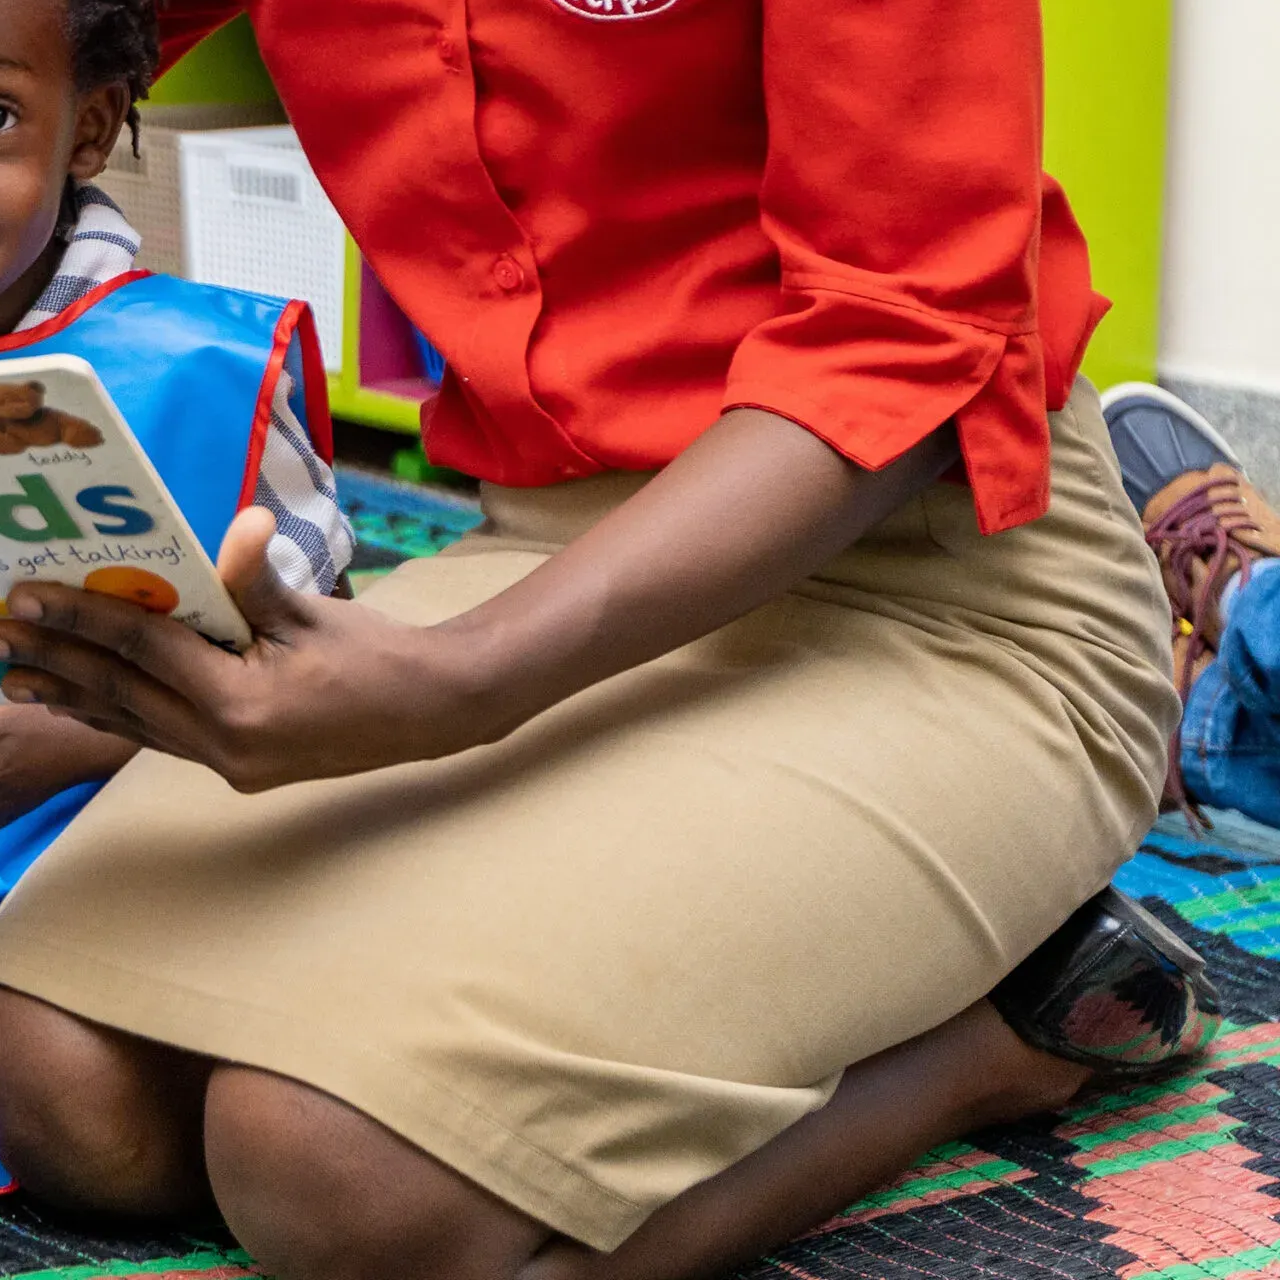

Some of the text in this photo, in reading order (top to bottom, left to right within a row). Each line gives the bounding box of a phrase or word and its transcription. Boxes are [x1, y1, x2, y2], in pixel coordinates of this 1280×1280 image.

[28, 451, 92, 467] teddy
[18, 546, 65, 576] get
[68, 535, 187, 565] talking!
